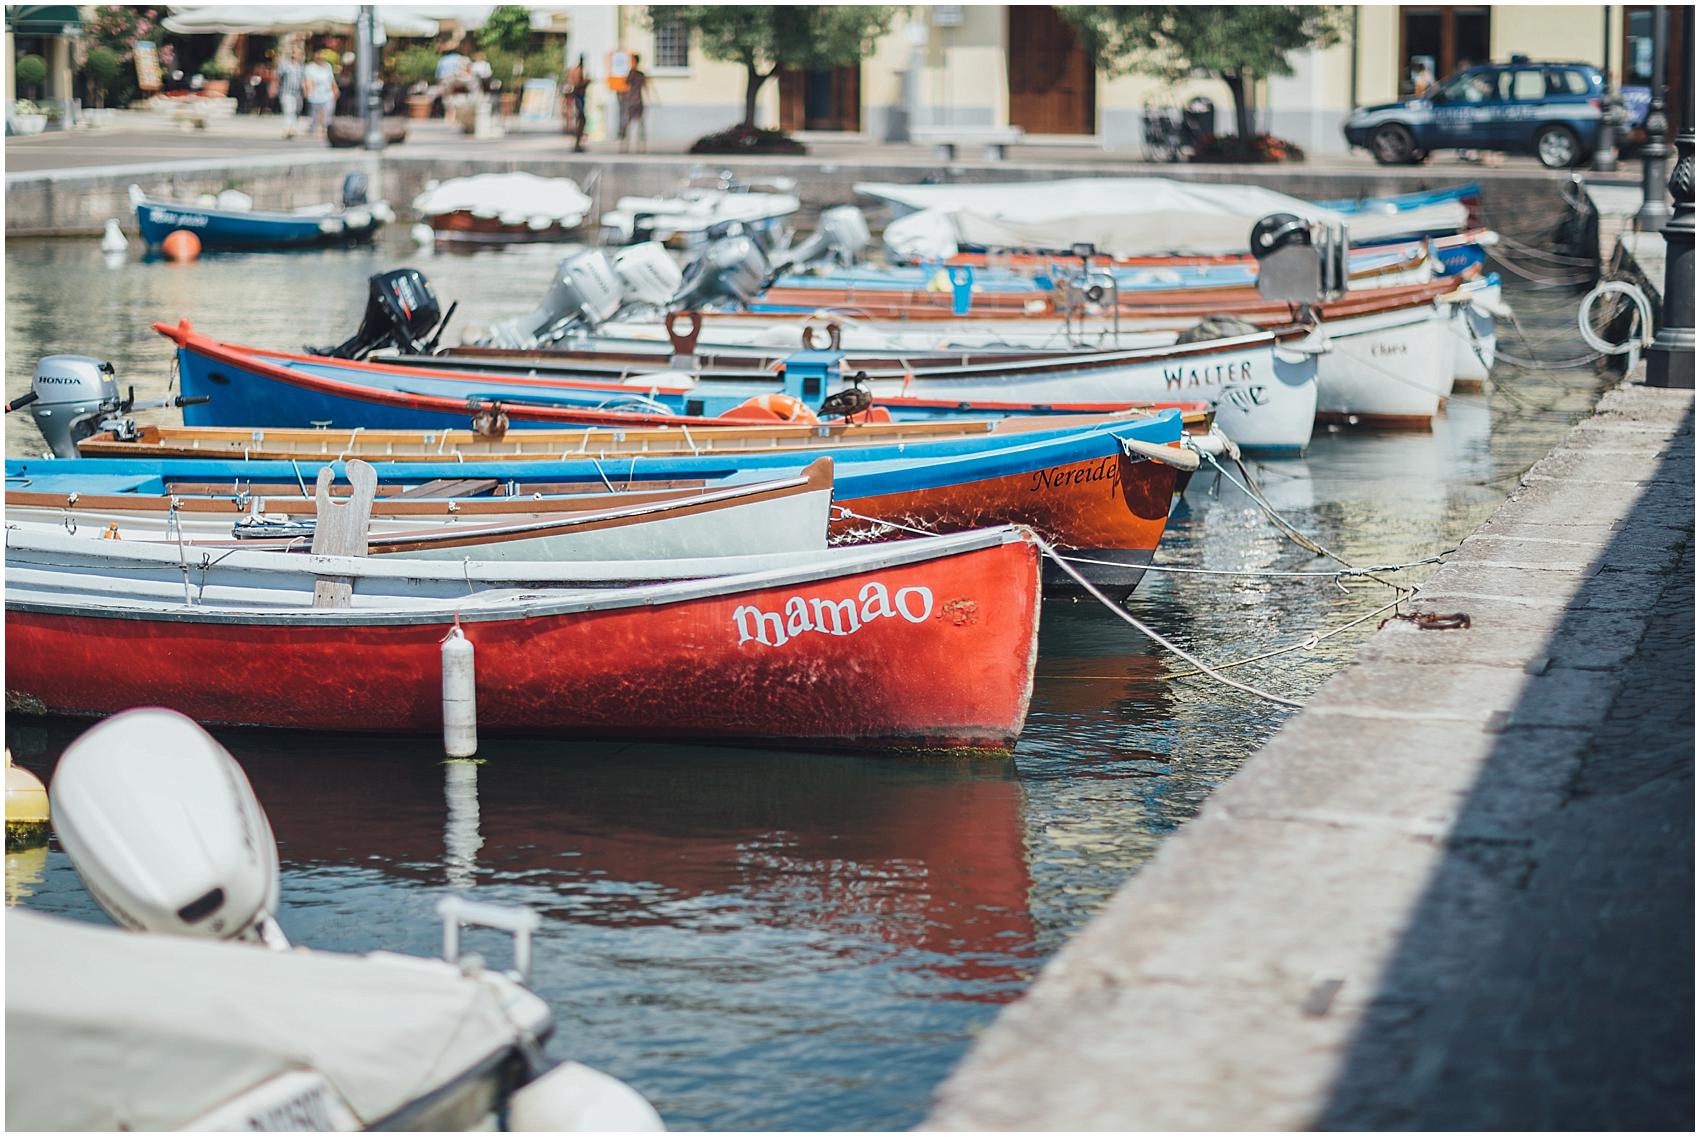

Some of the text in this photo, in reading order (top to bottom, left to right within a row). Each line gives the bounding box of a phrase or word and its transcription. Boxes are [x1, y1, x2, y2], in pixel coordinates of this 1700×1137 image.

[38, 375, 82, 385] HONDA
[1164, 361, 1252, 393] WALTER
[1031, 457, 1116, 492] Nereide
[732, 582, 933, 647] mamao
